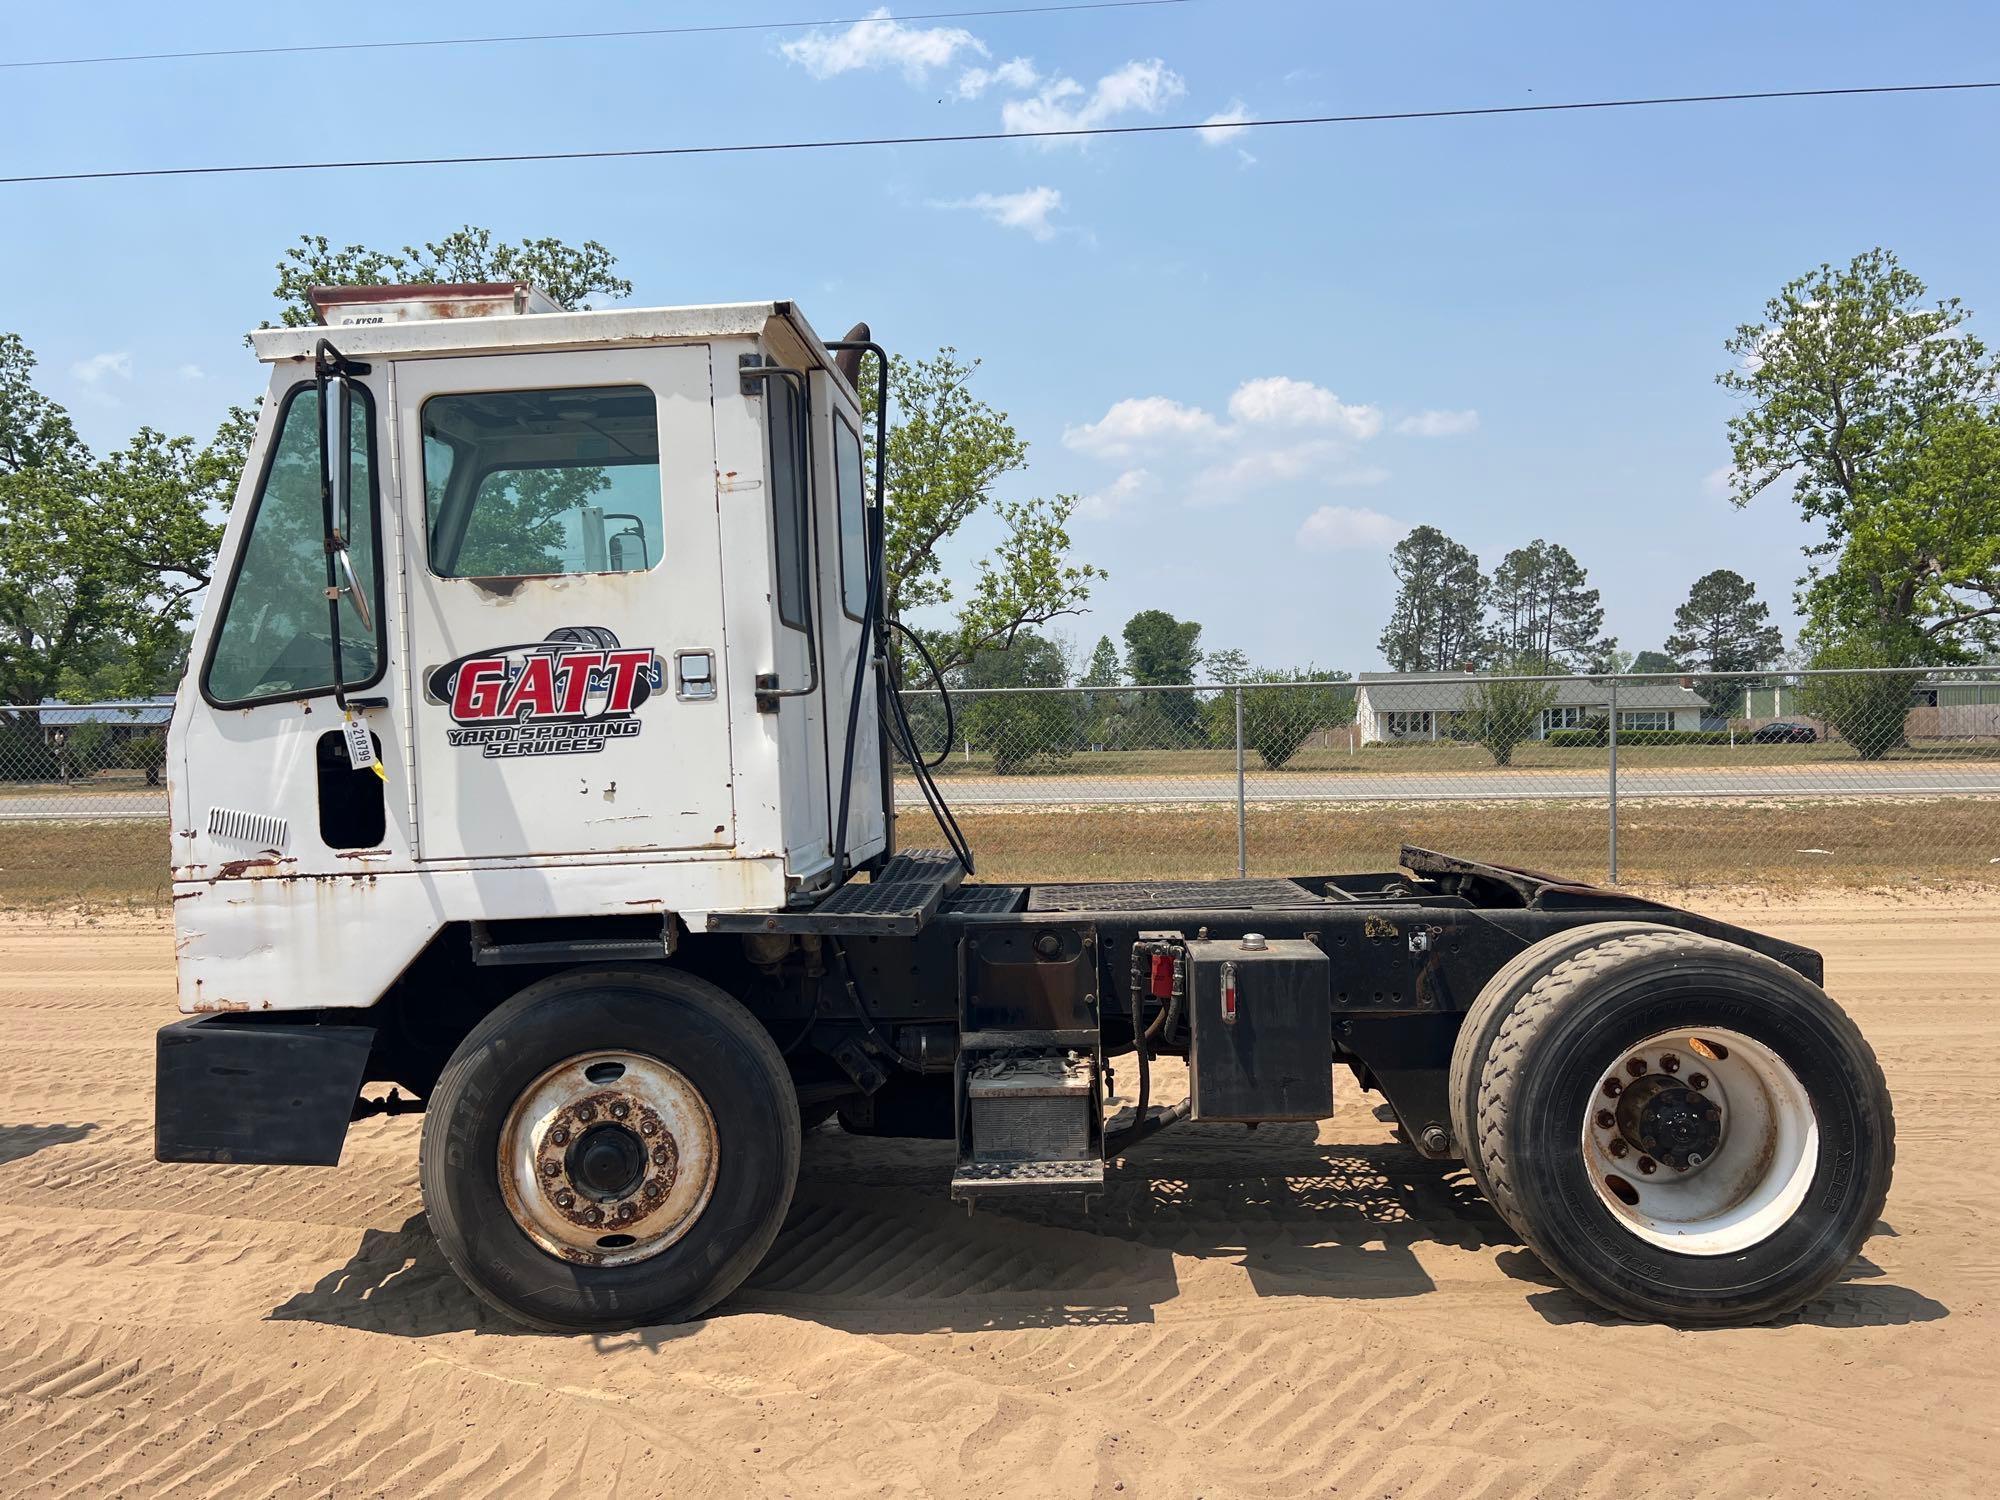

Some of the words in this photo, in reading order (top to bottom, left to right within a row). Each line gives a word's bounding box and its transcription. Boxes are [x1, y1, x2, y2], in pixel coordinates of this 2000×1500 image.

[450, 648, 655, 723] GATT
[353, 728, 371, 762] 218799
[448, 727, 513, 745] YARD
[519, 720, 640, 742] SPOTTING
[484, 737, 604, 757] SERVICES
